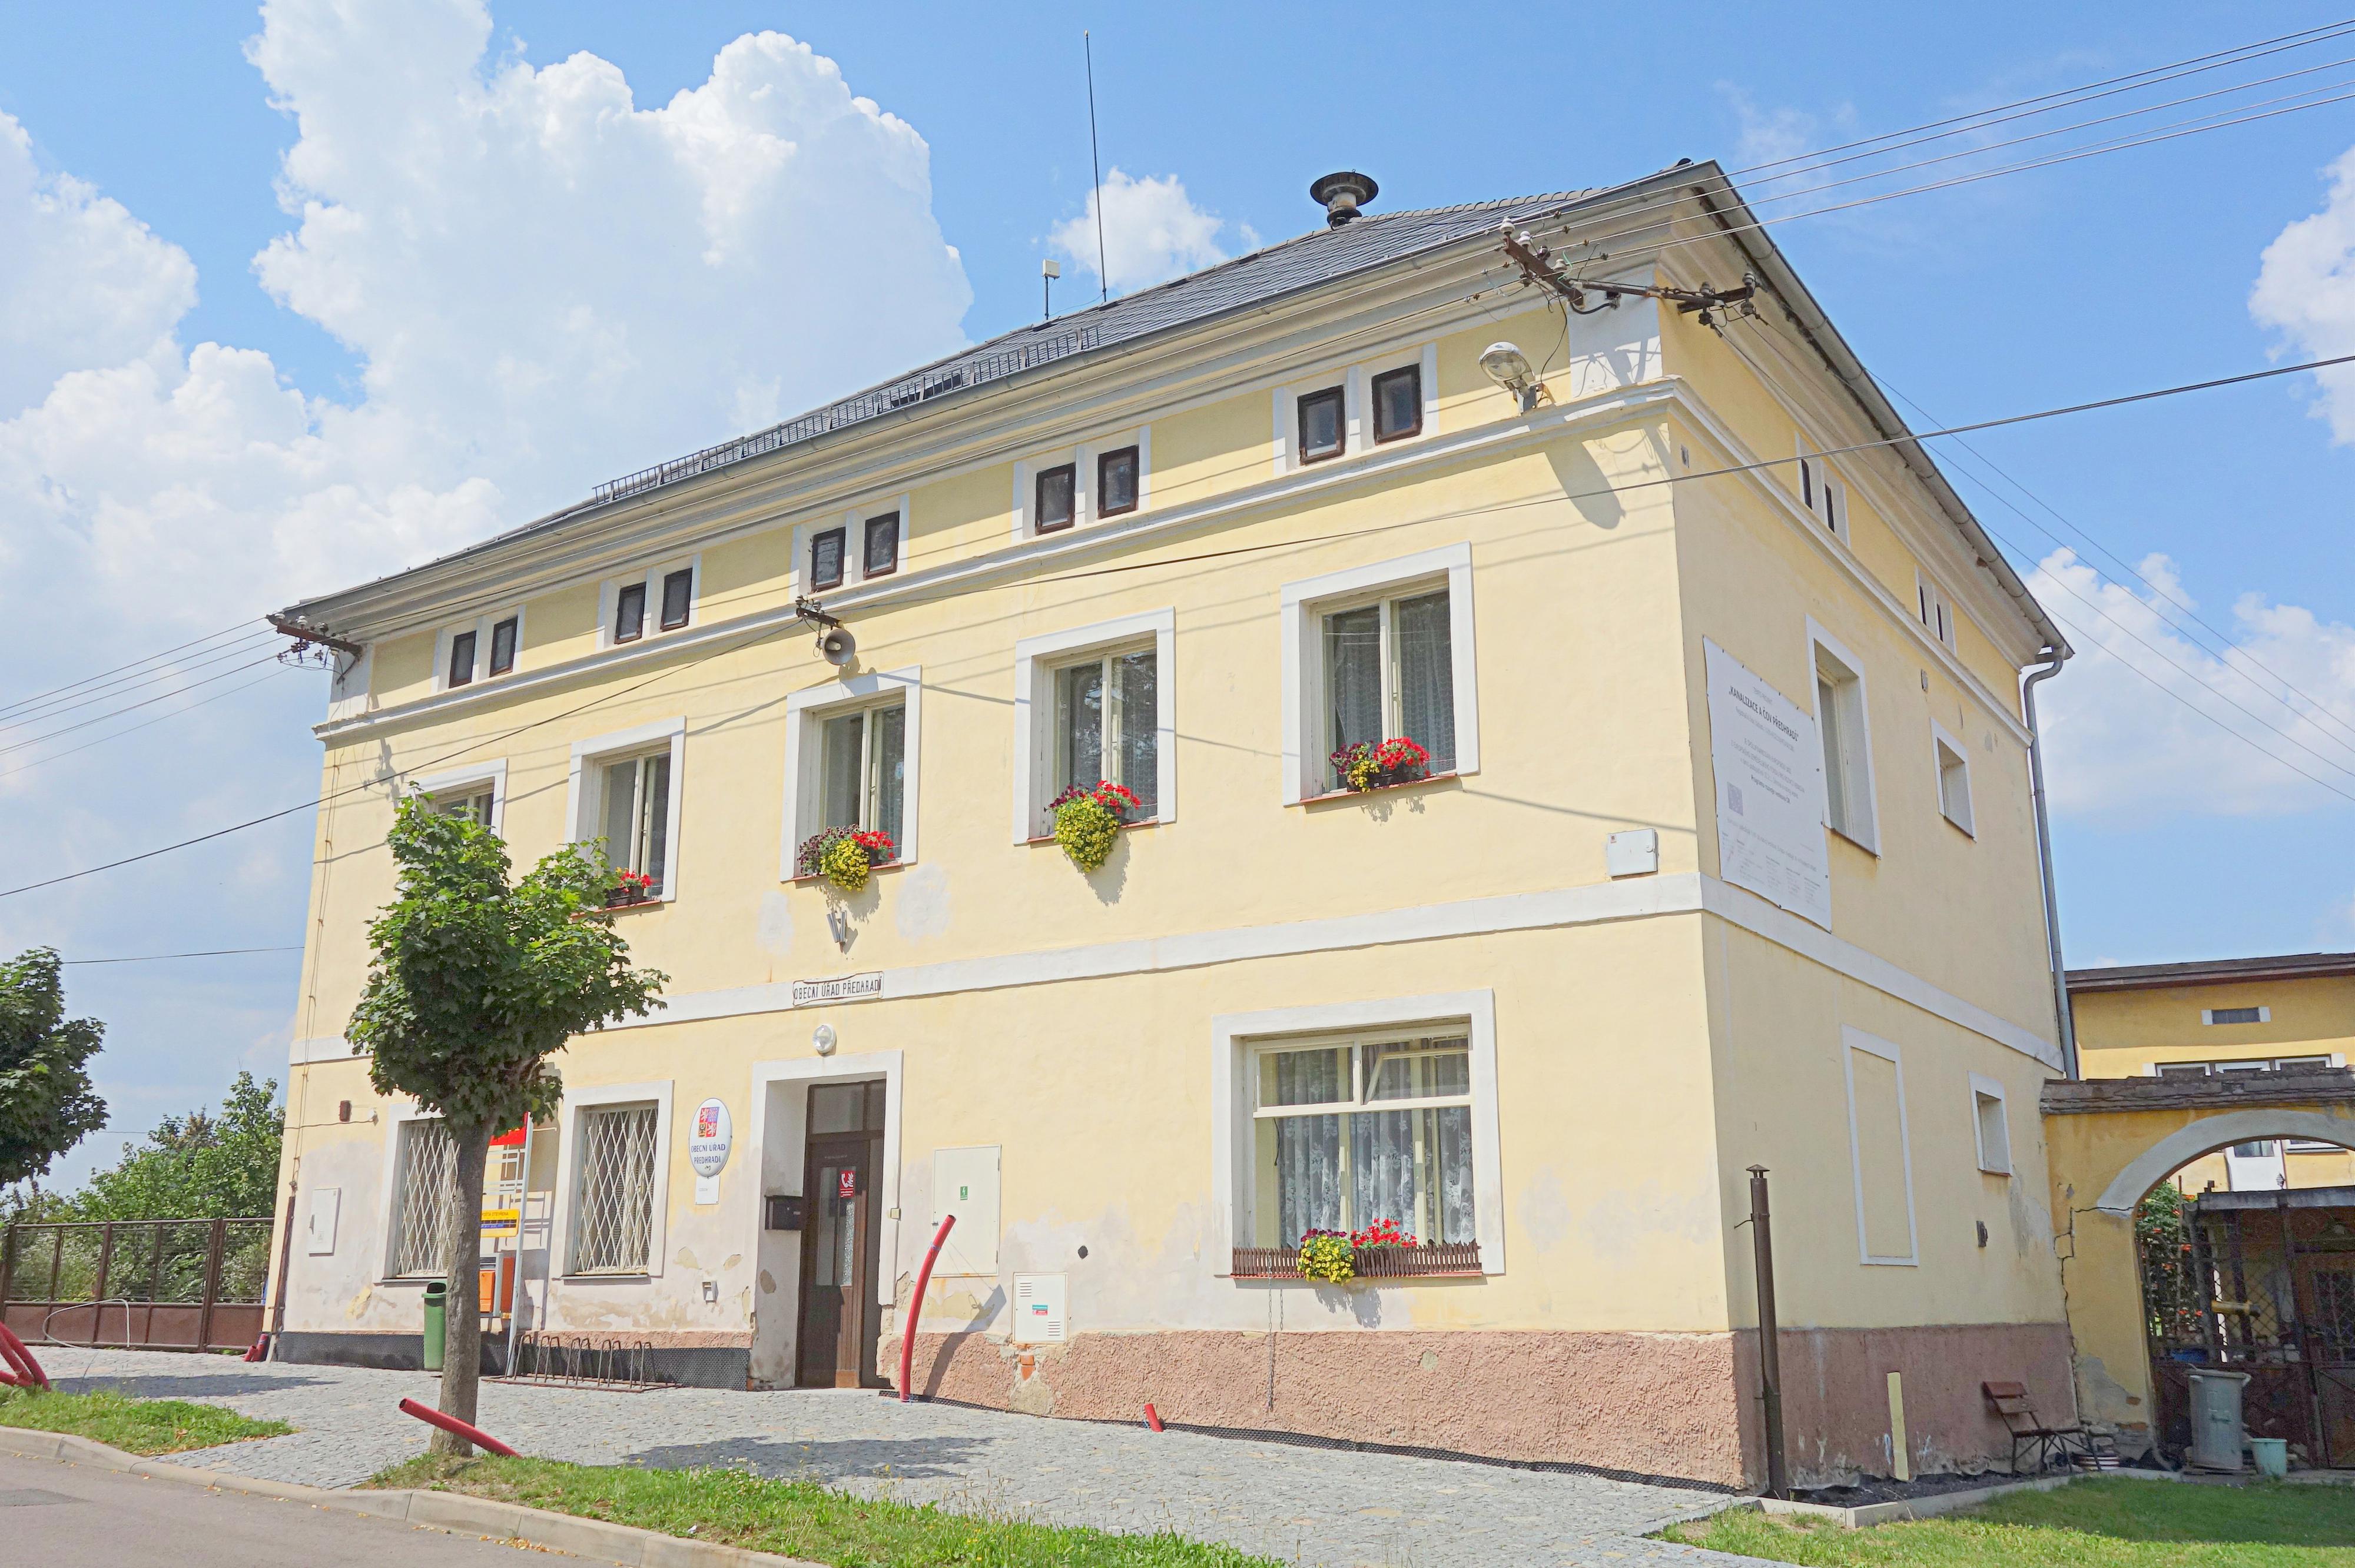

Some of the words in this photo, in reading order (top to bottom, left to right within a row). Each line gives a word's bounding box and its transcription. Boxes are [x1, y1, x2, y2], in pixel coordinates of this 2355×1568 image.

[1759, 707, 1762, 716] A
[821, 982, 840, 997] ÚŘAD
[691, 1142, 708, 1152] OBECNÍ
[709, 1142, 726, 1151] ÚŘAD
[694, 1154, 721, 1164] PŘEDHRADÍ
